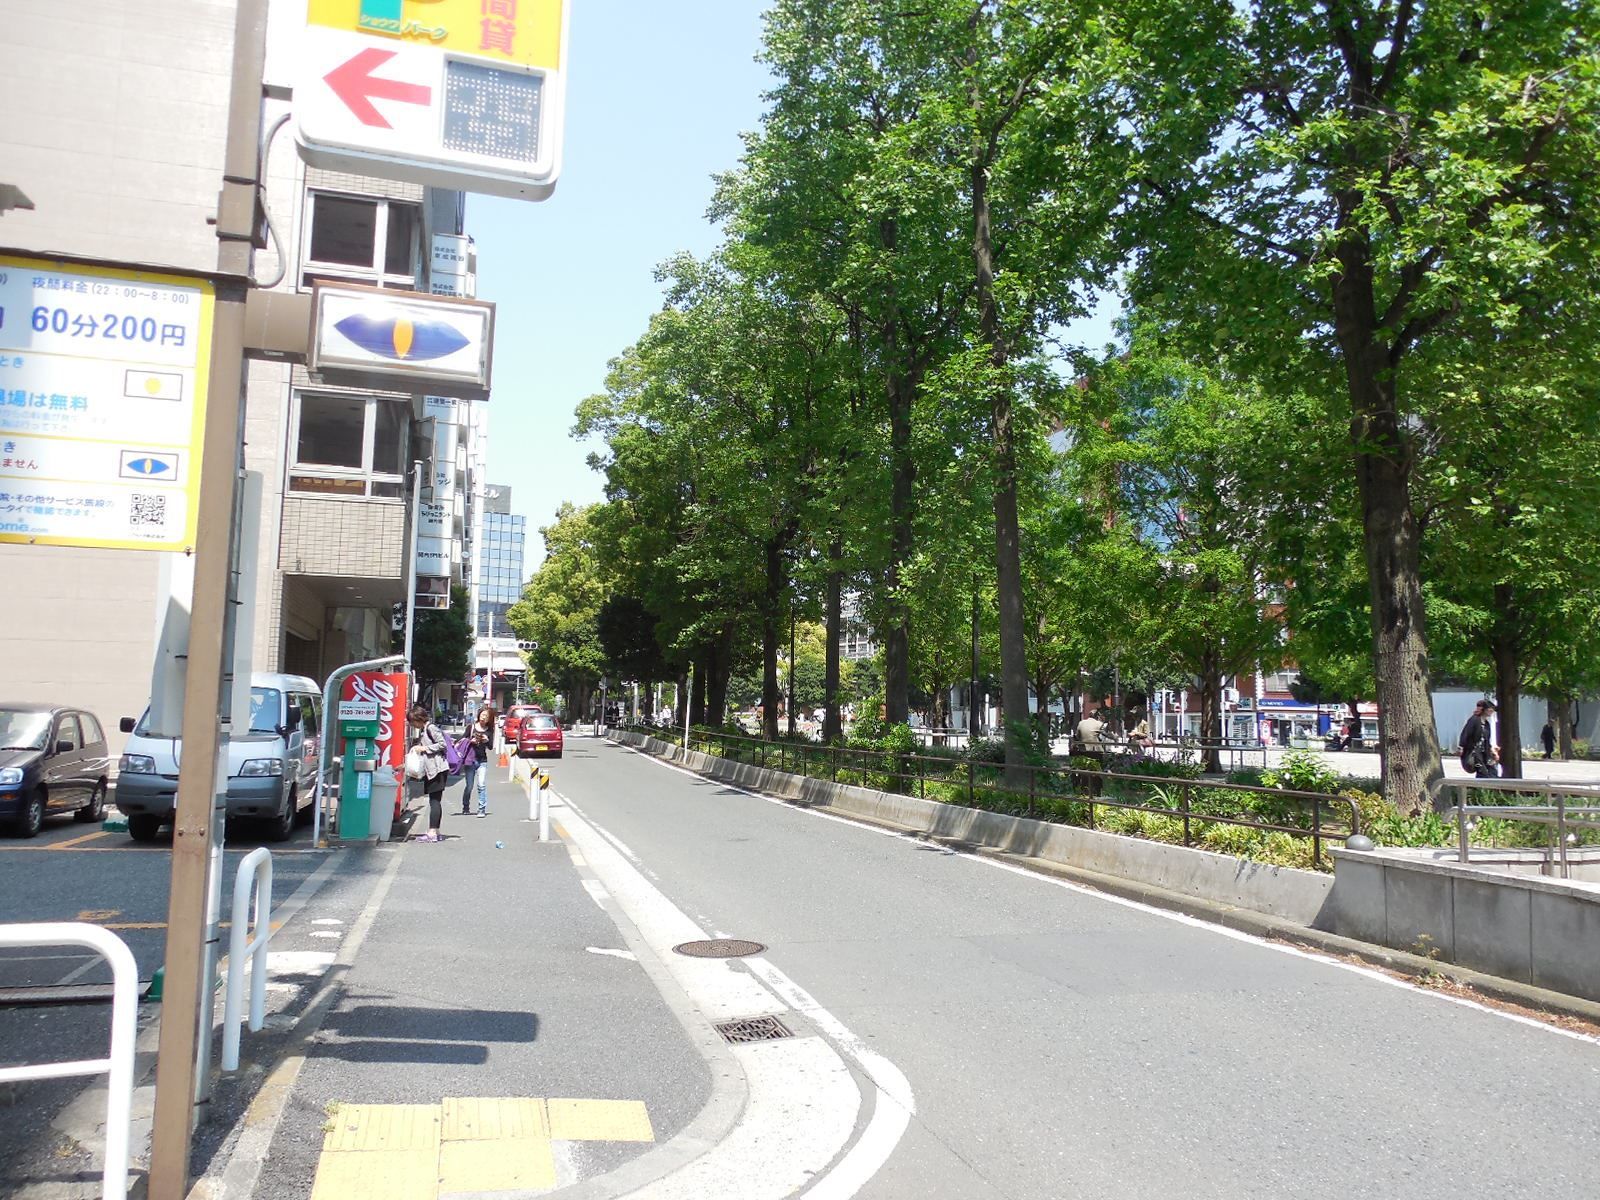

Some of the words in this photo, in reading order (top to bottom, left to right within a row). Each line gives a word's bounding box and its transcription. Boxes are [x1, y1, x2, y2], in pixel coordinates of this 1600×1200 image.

[32, 306, 187, 347] 60分200円
[0, 458, 38, 470] ません
